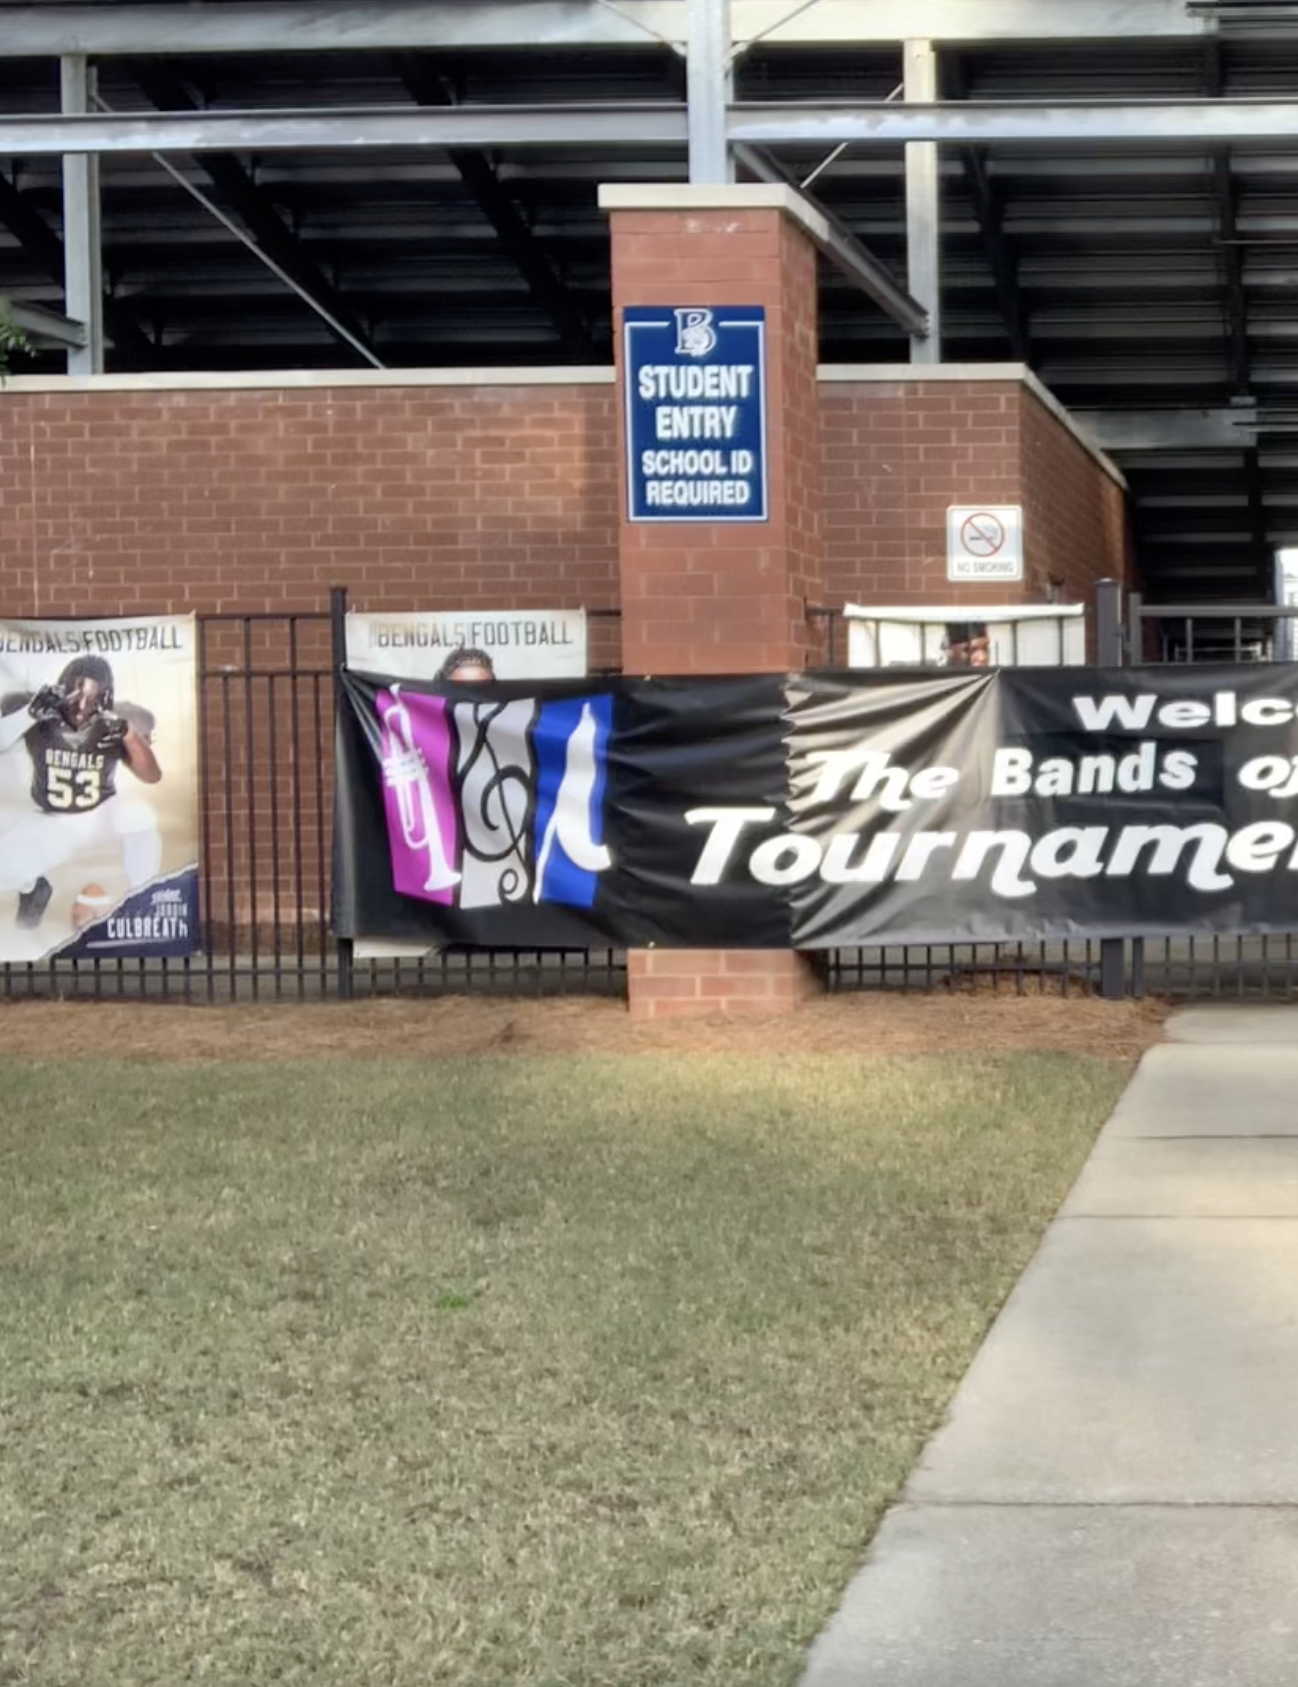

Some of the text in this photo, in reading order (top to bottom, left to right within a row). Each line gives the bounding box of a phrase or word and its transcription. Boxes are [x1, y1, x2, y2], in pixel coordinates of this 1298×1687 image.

[638, 364, 753, 400] STUDENT
[655, 405, 737, 440] ENTRY
[641, 448, 753, 476] SCHOOL ID
[645, 480, 750, 506] REQUIRED
[0, 625, 183, 655] ENGALS FOOTBALL
[377, 620, 573, 648] BENGALS FOOTBALL
[47, 766, 100, 808] 53
[806, 749, 960, 812] The
[990, 741, 1198, 797] Bands
